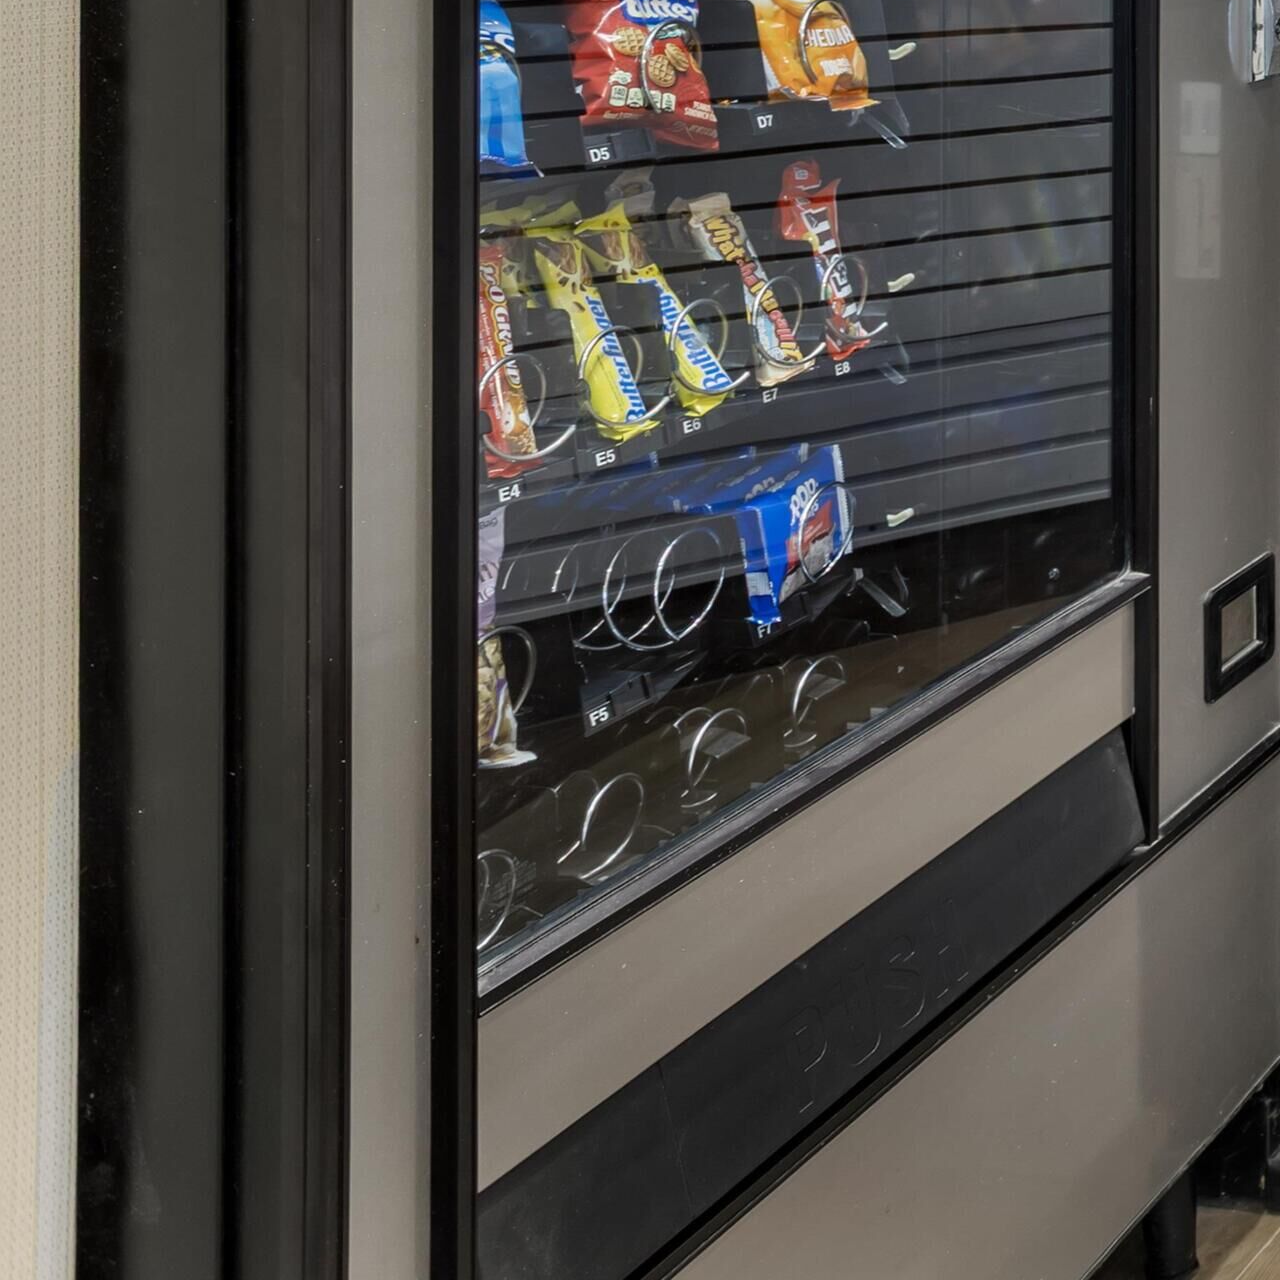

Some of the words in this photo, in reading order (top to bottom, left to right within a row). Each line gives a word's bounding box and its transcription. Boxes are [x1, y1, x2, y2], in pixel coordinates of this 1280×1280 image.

[756, 114, 774, 129] D7
[588, 147, 611, 163] D5
[834, 360, 851, 376] E8
[762, 388, 778, 404] E7
[683, 419, 702, 435] E6
[595, 450, 616, 467] E5
[498, 484, 522, 503] E4
[757, 623, 774, 639] F7
[589, 708, 610, 728] F5
